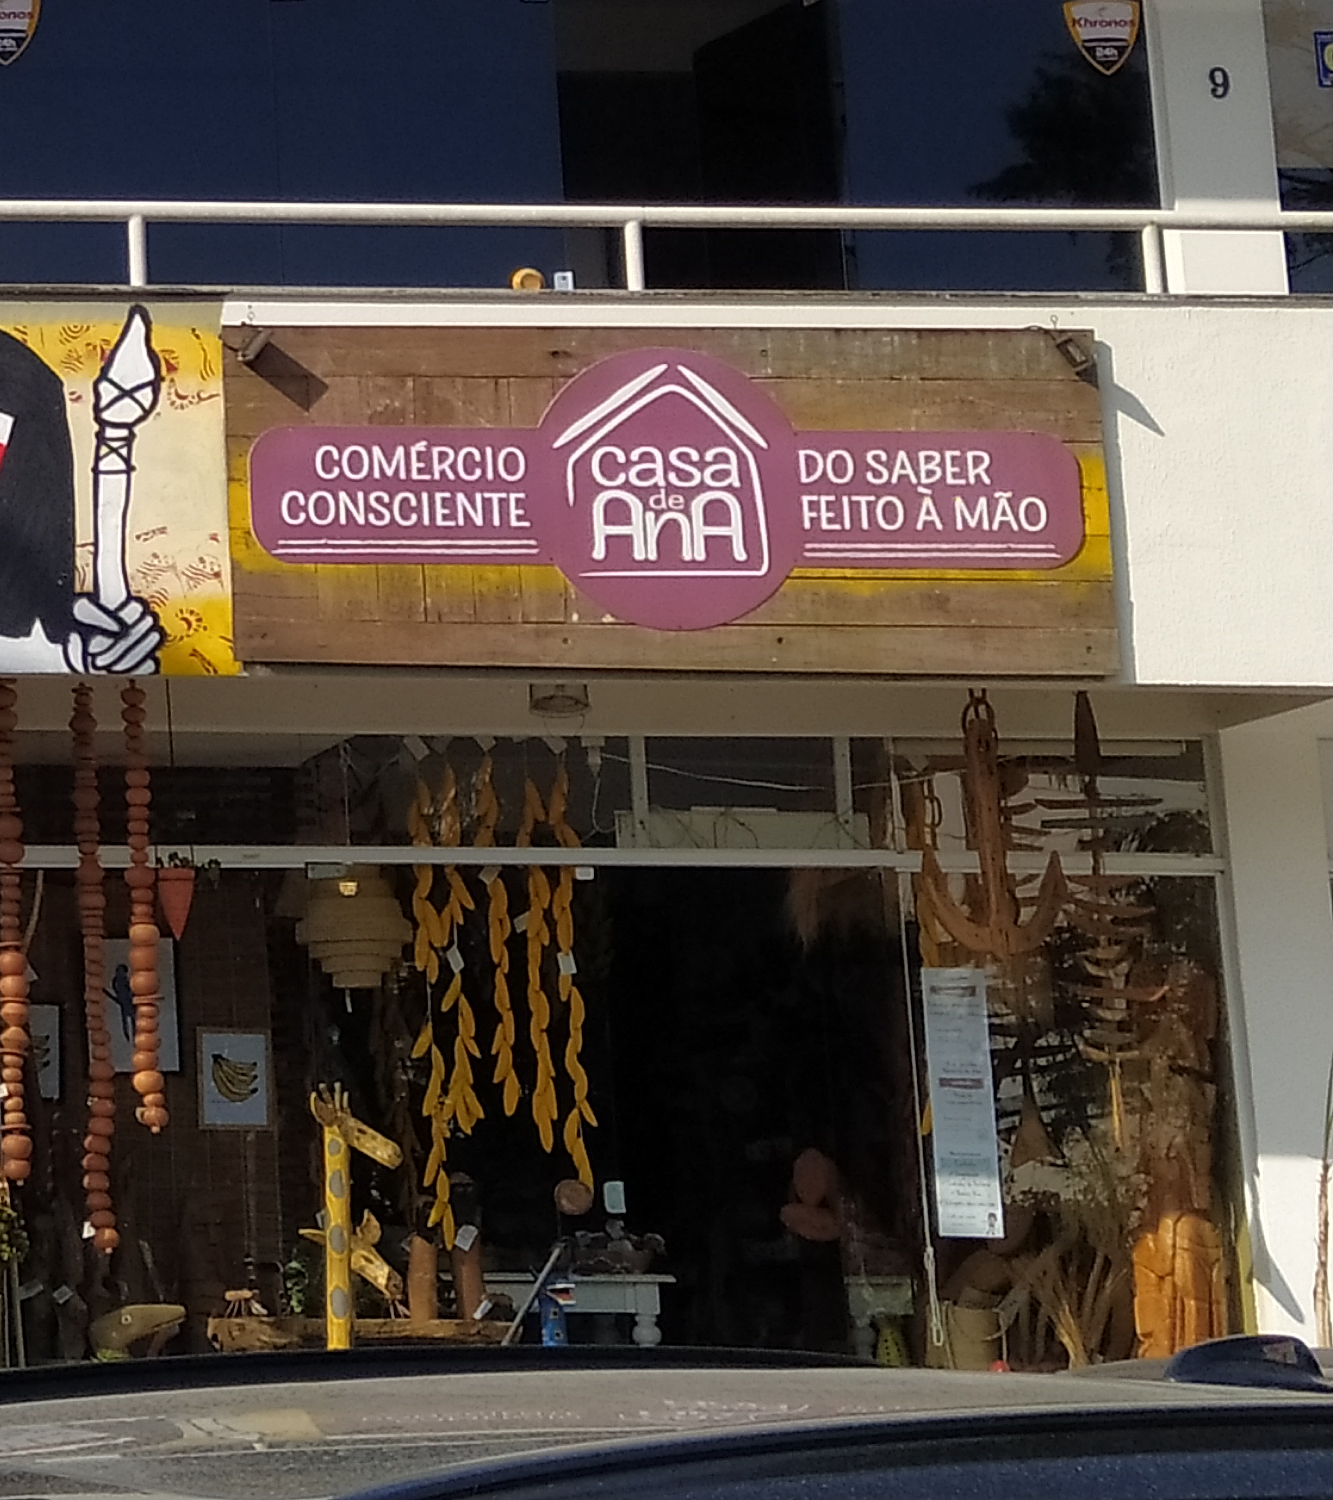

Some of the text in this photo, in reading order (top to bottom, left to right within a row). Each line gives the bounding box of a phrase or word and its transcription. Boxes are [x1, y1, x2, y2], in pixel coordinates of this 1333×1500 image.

[1072, 17, 1136, 29] Khronos
[1209, 66, 1231, 99] 9
[314, 440, 526, 481] COMÉRCIO
[591, 444, 742, 490] casa
[797, 447, 993, 485] DO SABER
[280, 490, 532, 529] CONSCIENTE
[649, 488, 685, 511] de
[801, 485, 1049, 533] FEITO À MÃO
